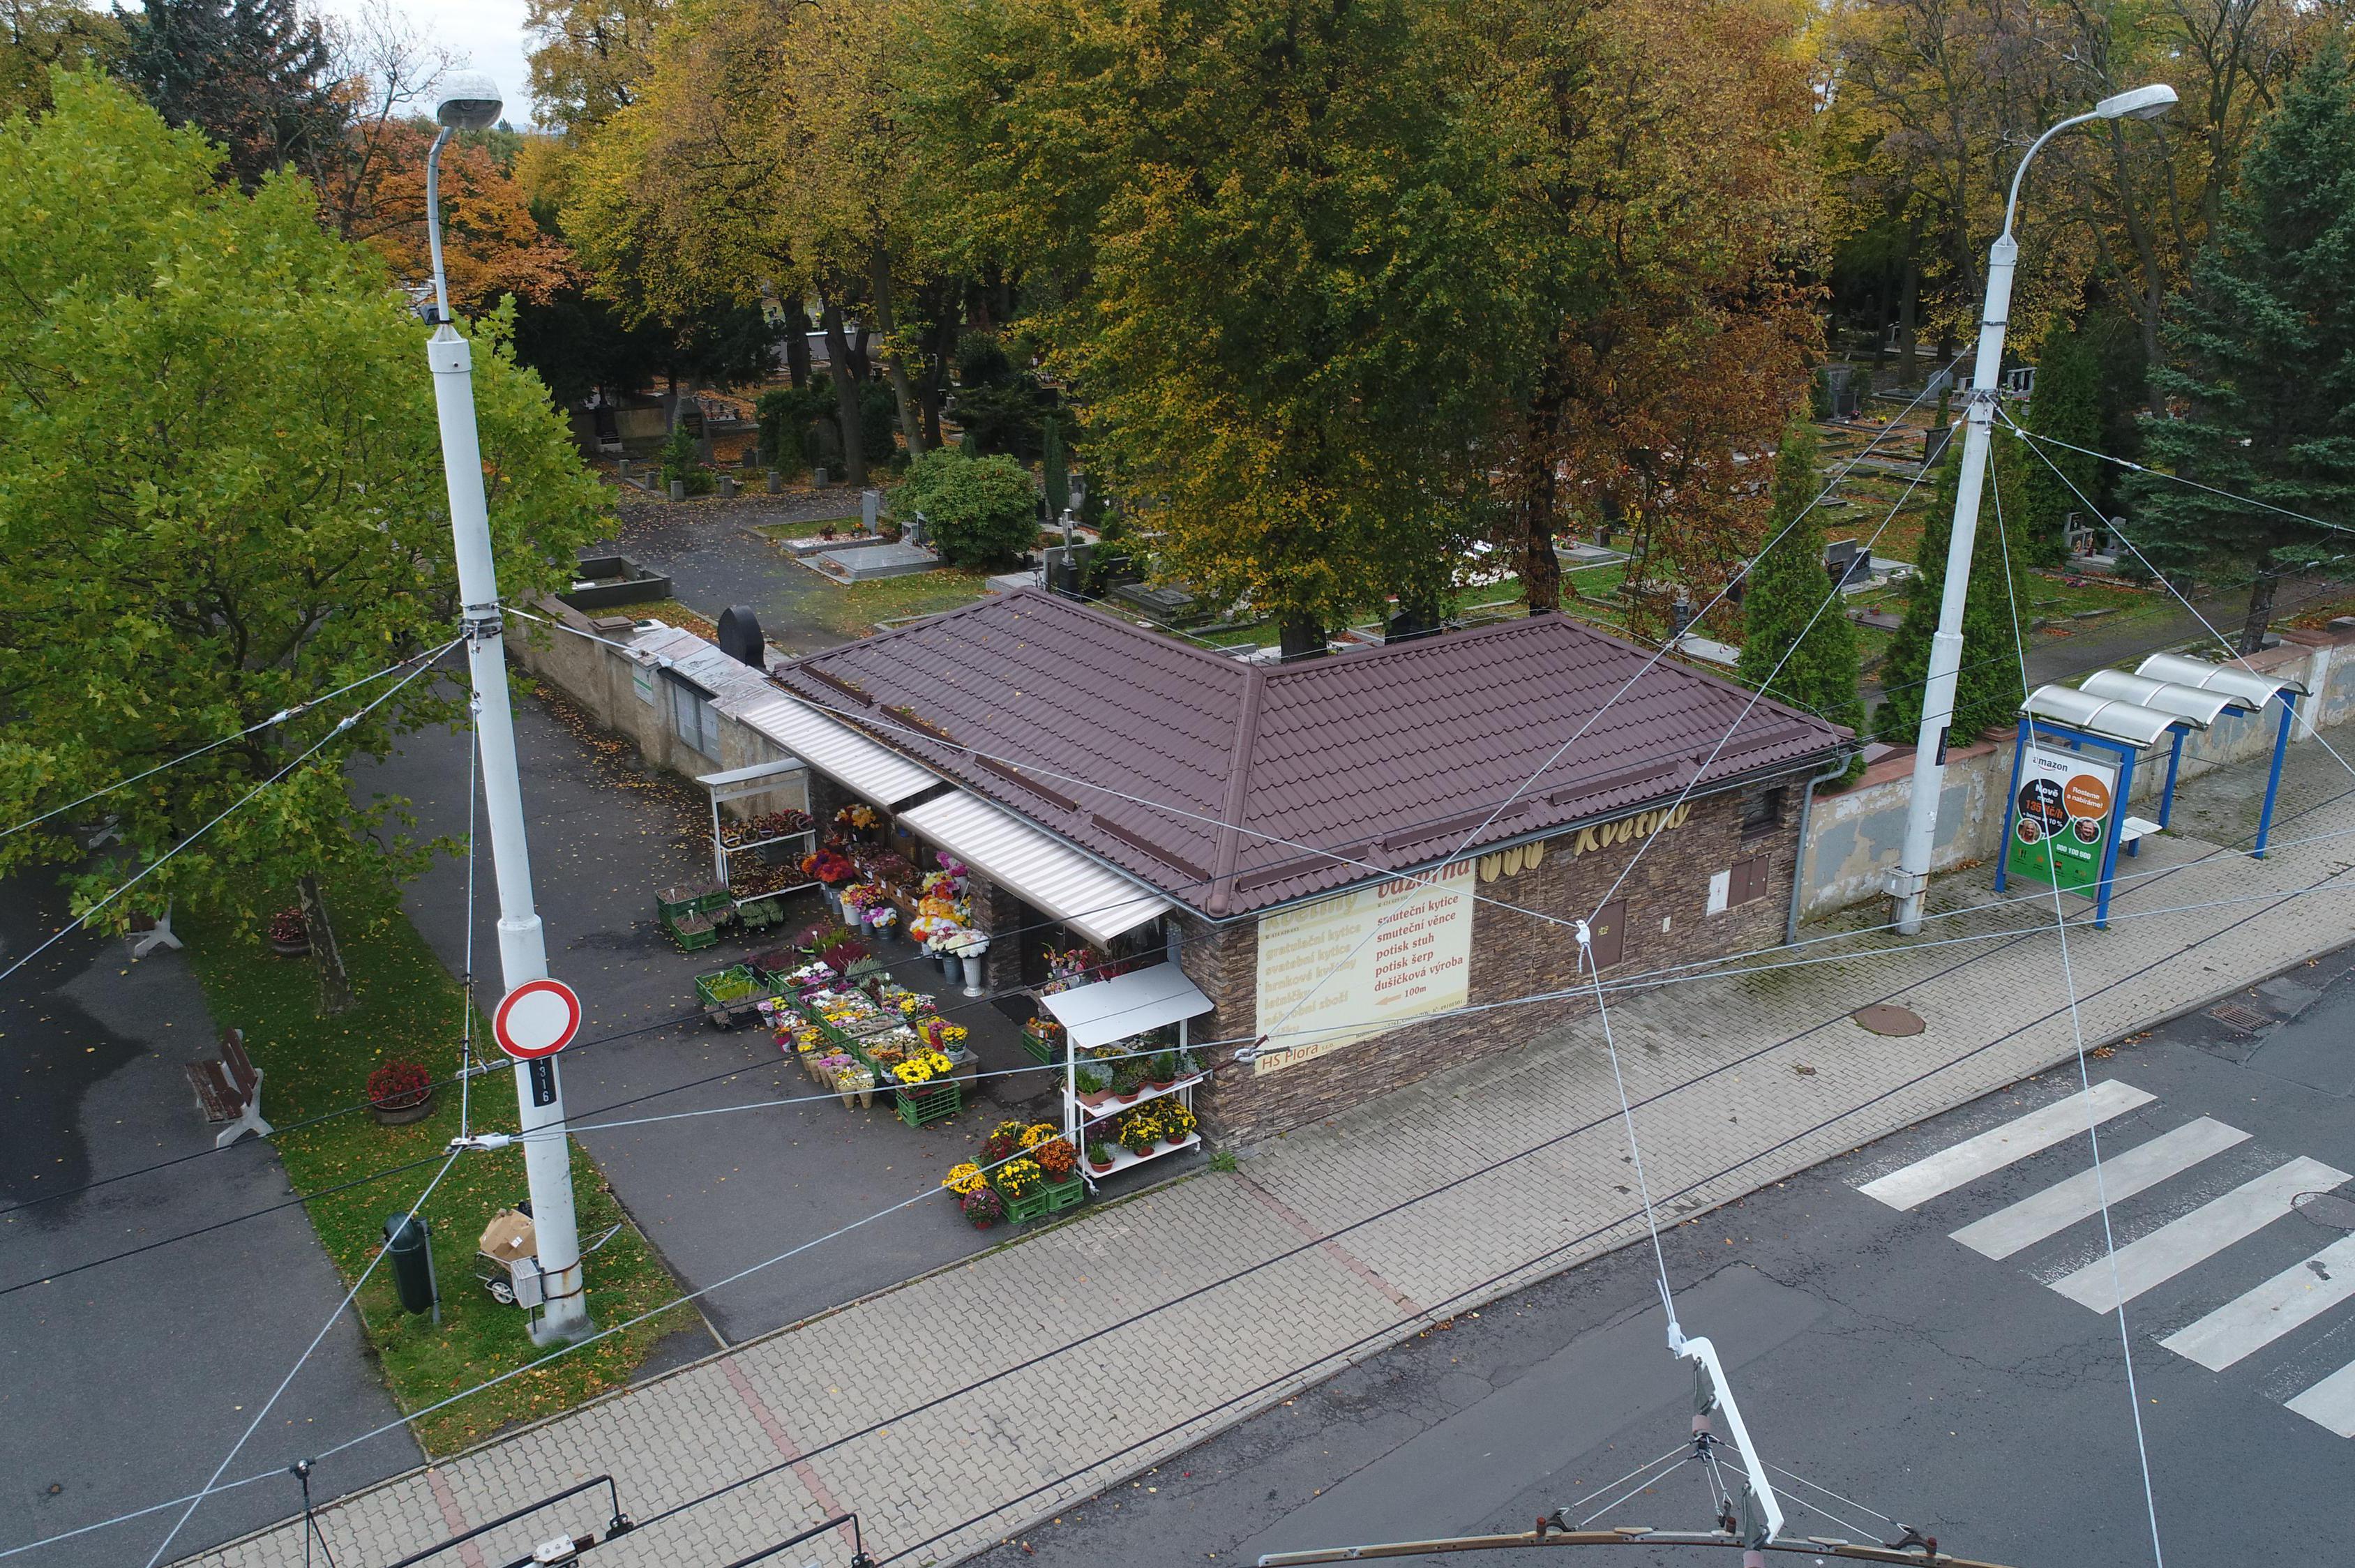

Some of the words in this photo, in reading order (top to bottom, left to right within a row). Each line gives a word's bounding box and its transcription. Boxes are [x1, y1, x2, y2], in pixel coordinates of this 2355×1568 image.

[1428, 896, 1459, 912] kytice
[1377, 919, 1424, 942] smuteční
[1427, 912, 1456, 927] věnce
[1376, 941, 1408, 961] potisk
[1412, 933, 1434, 948] stuh
[1374, 967, 1427, 992] dušičková
[1429, 956, 1464, 974] výroba
[1376, 958, 1408, 978] potisk
[1411, 951, 1434, 965] šerp
[1404, 986, 1427, 997] 100m
[1262, 1054, 1281, 1070] HS
